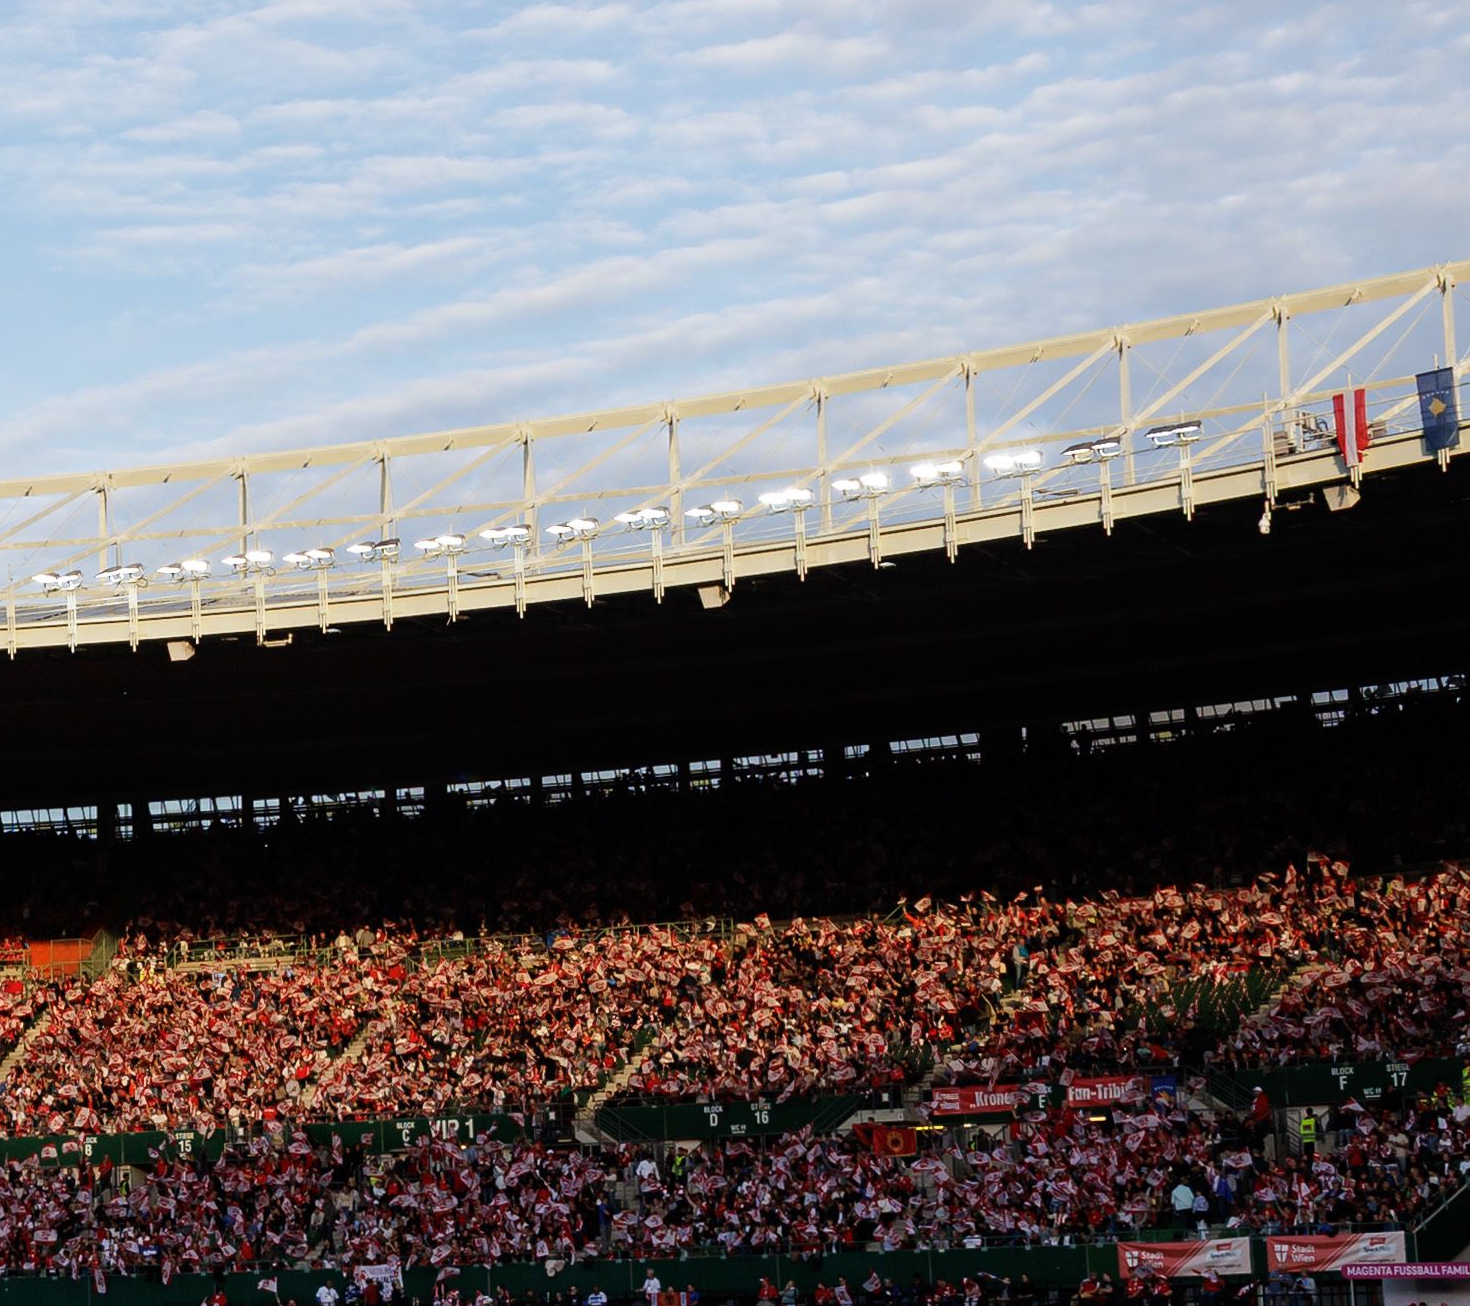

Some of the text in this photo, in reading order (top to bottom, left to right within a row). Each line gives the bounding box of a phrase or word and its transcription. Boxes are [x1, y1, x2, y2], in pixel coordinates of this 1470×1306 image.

[1331, 1067, 1354, 1075] BLOCK
[1339, 1075, 1348, 1090] F
[1391, 1072, 1407, 1087] 17
[703, 1105, 723, 1113] BLOCK
[709, 1113, 718, 1127] D
[754, 1111, 769, 1124] 16
[396, 1121, 415, 1129] BLOCK
[465, 1118, 474, 1139] 1
[401, 1129, 410, 1142] C
[84, 1144, 93, 1157] B
[179, 1140, 192, 1152] 15
[1291, 1244, 1316, 1254] Stadt
[1141, 1251, 1165, 1260] Stadt
[1291, 1253, 1315, 1263] Wien
[1346, 1266, 1393, 1276] MAGENTA
[1393, 1265, 1441, 1276] FUSSBALL
